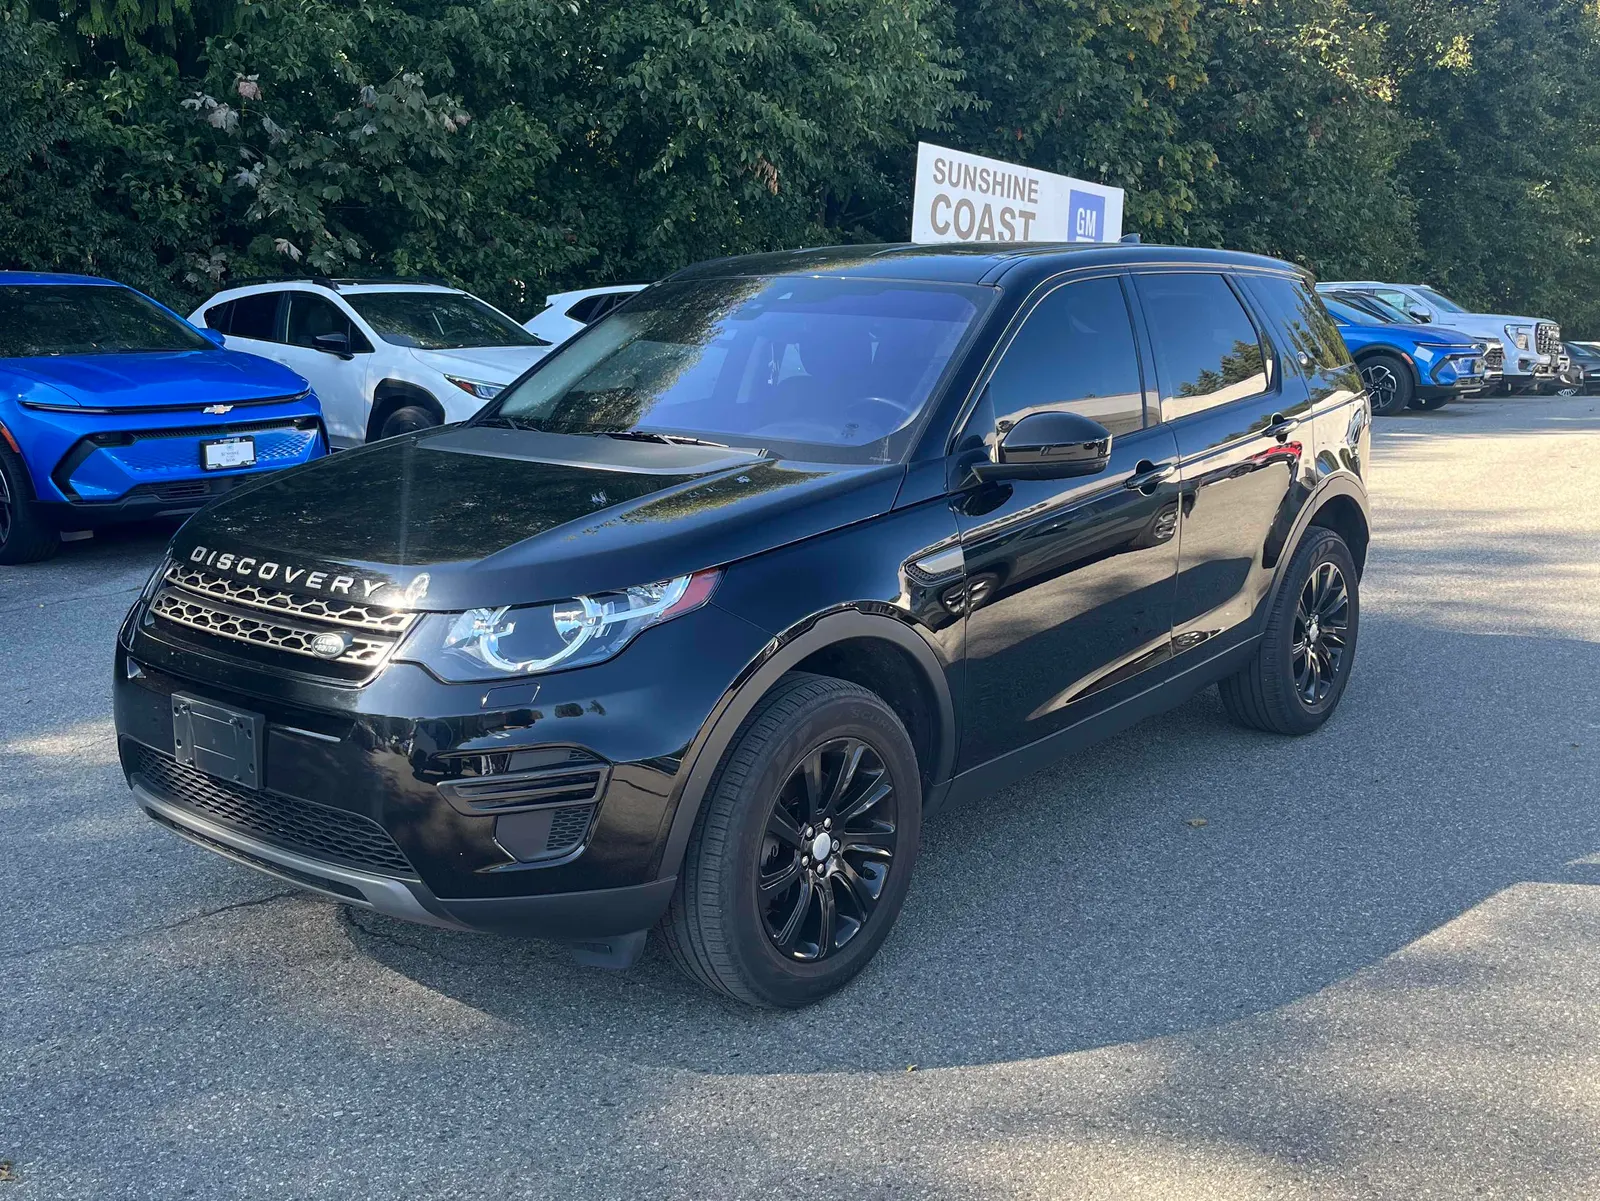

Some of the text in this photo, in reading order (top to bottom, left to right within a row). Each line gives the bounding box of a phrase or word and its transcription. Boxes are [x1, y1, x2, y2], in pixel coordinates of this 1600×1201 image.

[933, 158, 1039, 204] SUNSHINE
[931, 193, 1036, 241] COAST
[1076, 207, 1096, 237] GM
[190, 546, 385, 597] DISCOVERY
